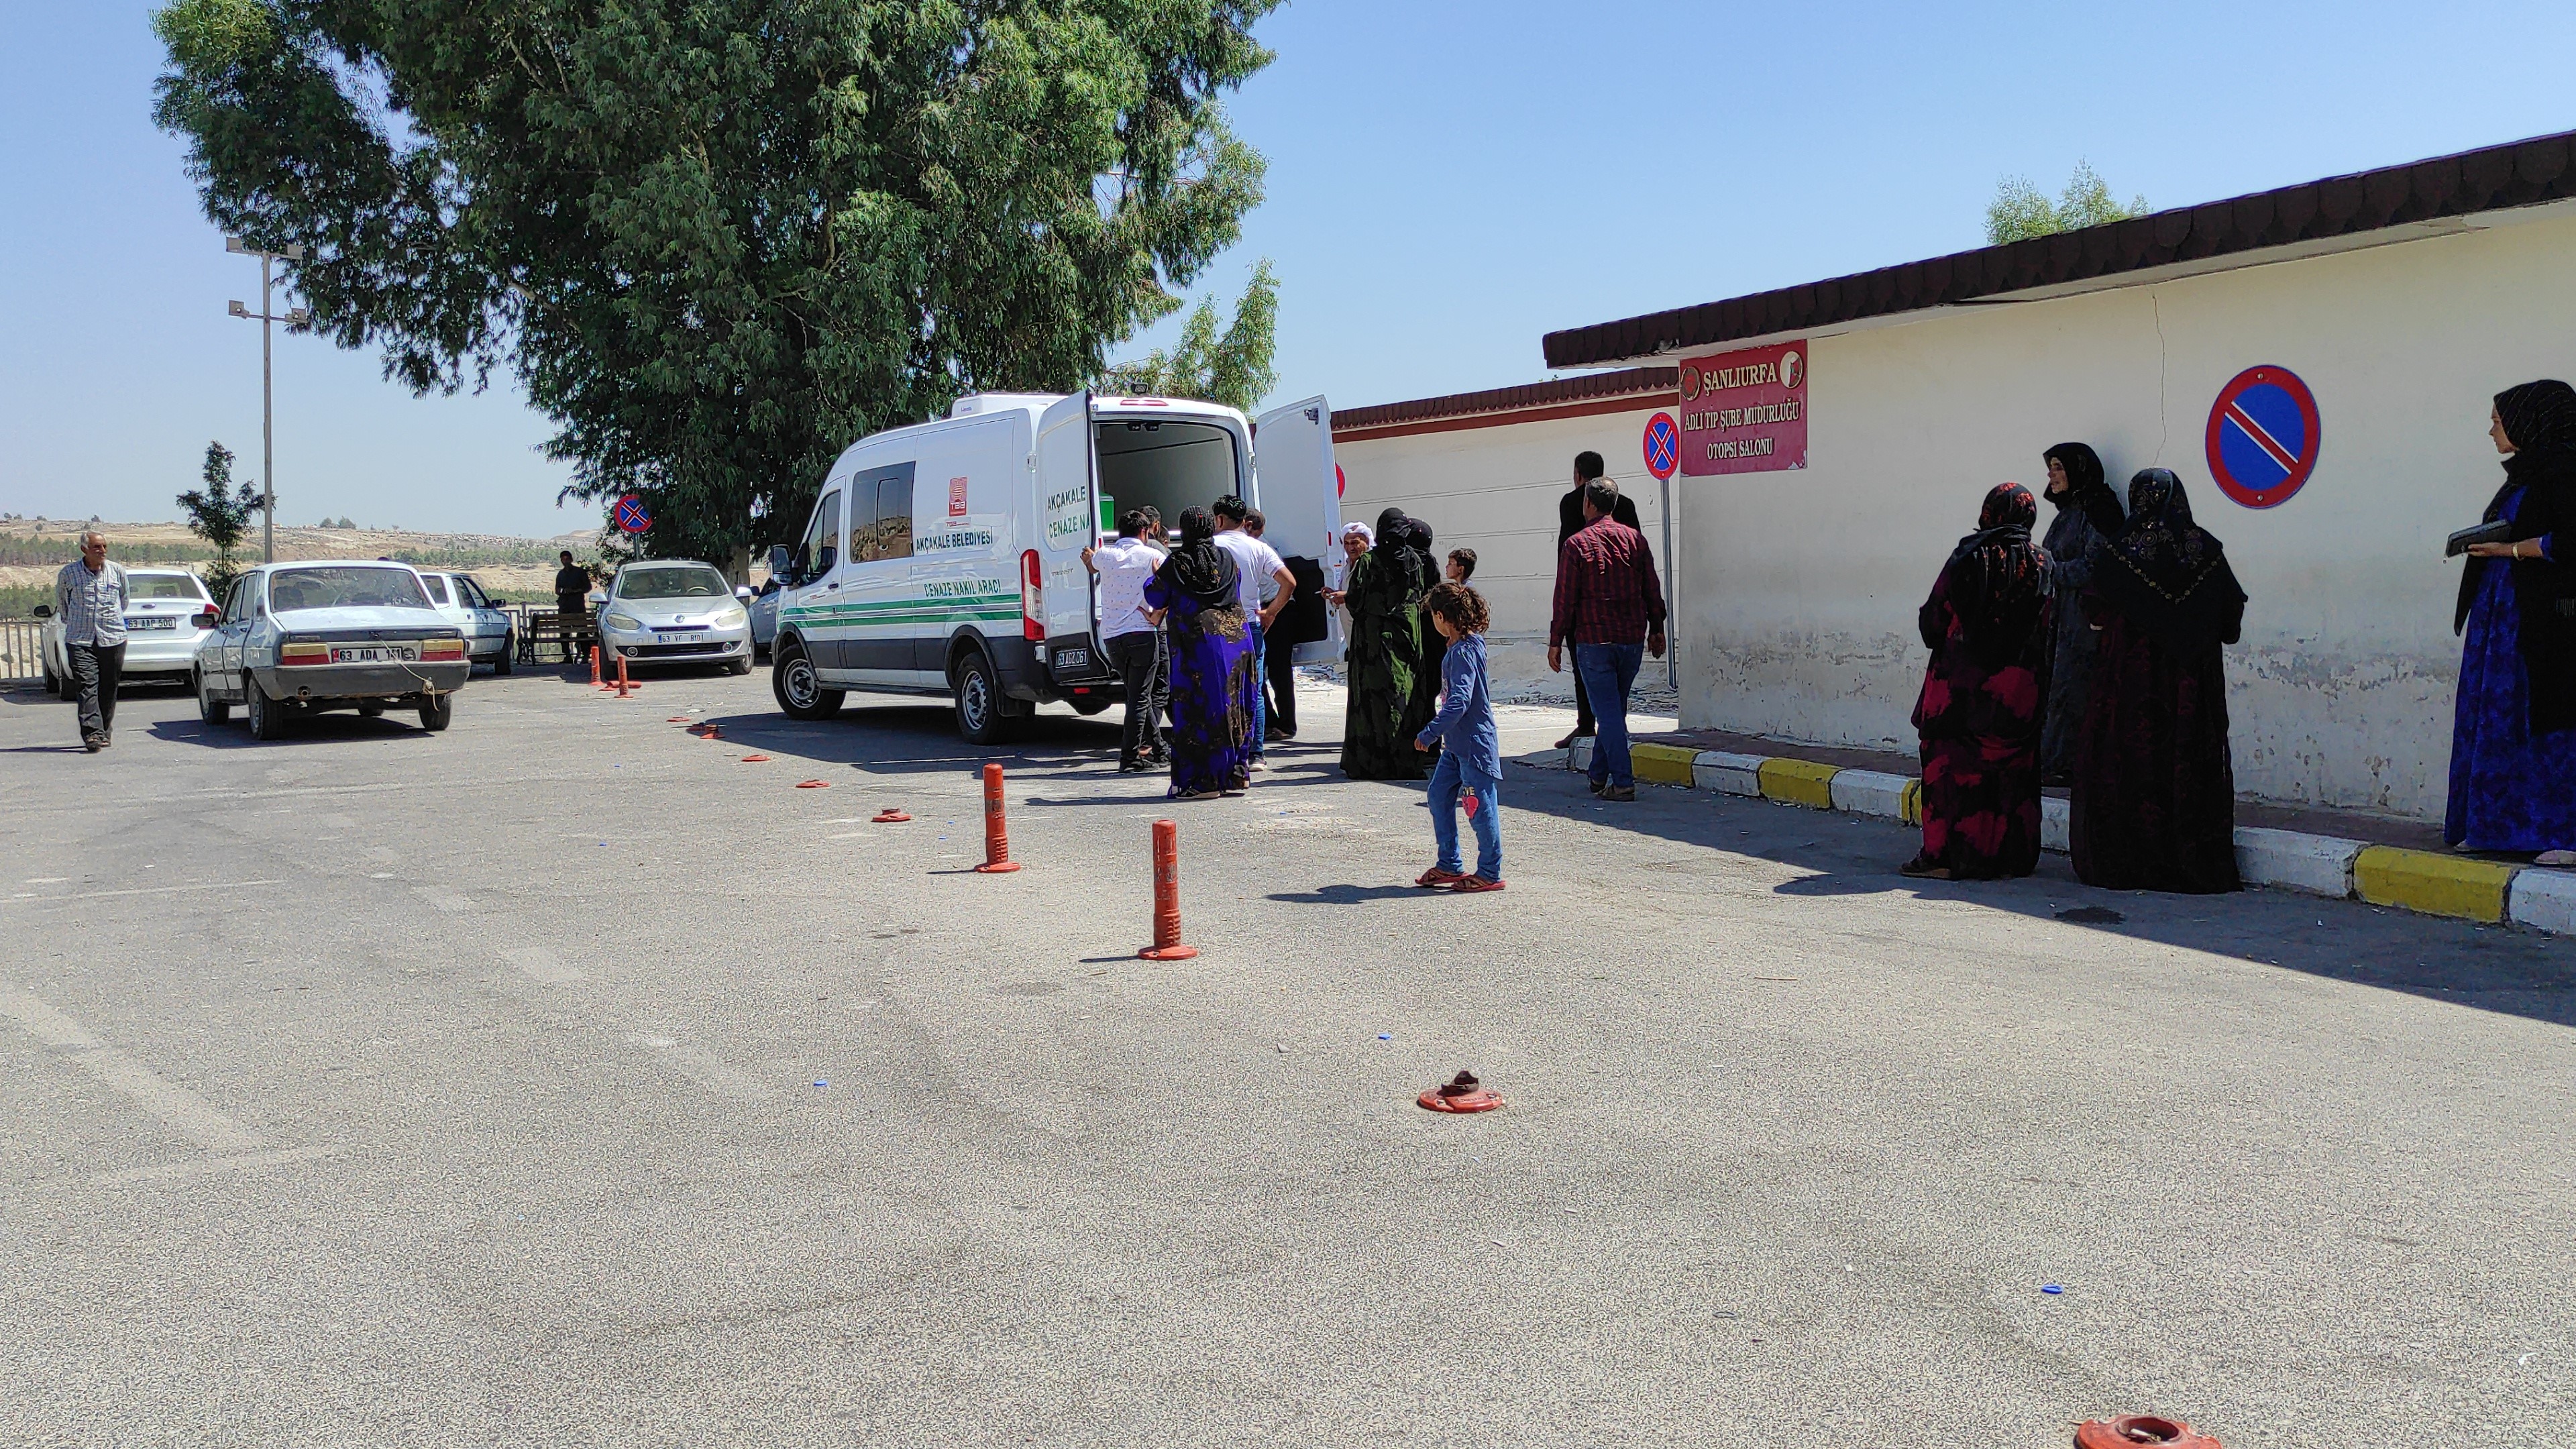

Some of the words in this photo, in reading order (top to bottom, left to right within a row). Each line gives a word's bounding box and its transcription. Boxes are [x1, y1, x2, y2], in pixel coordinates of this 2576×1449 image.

[1703, 362, 1777, 396] ŞANLIURFA
[1705, 412, 1719, 429] TIP
[1720, 409, 1742, 432] ŞUBE
[1739, 437, 1773, 457] SALONU
[1047, 486, 1086, 513] AKÇAKALE
[1049, 516, 1078, 538] CENAZE
[916, 535, 950, 554] AKÇAKALE
[924, 582, 952, 597] CENAZE
[953, 578, 976, 596] NAKİL
[977, 578, 1001, 594] ARACI
[339, 650, 352, 661] 63
[360, 649, 378, 661] ADA
[1076, 650, 1087, 663] 061
